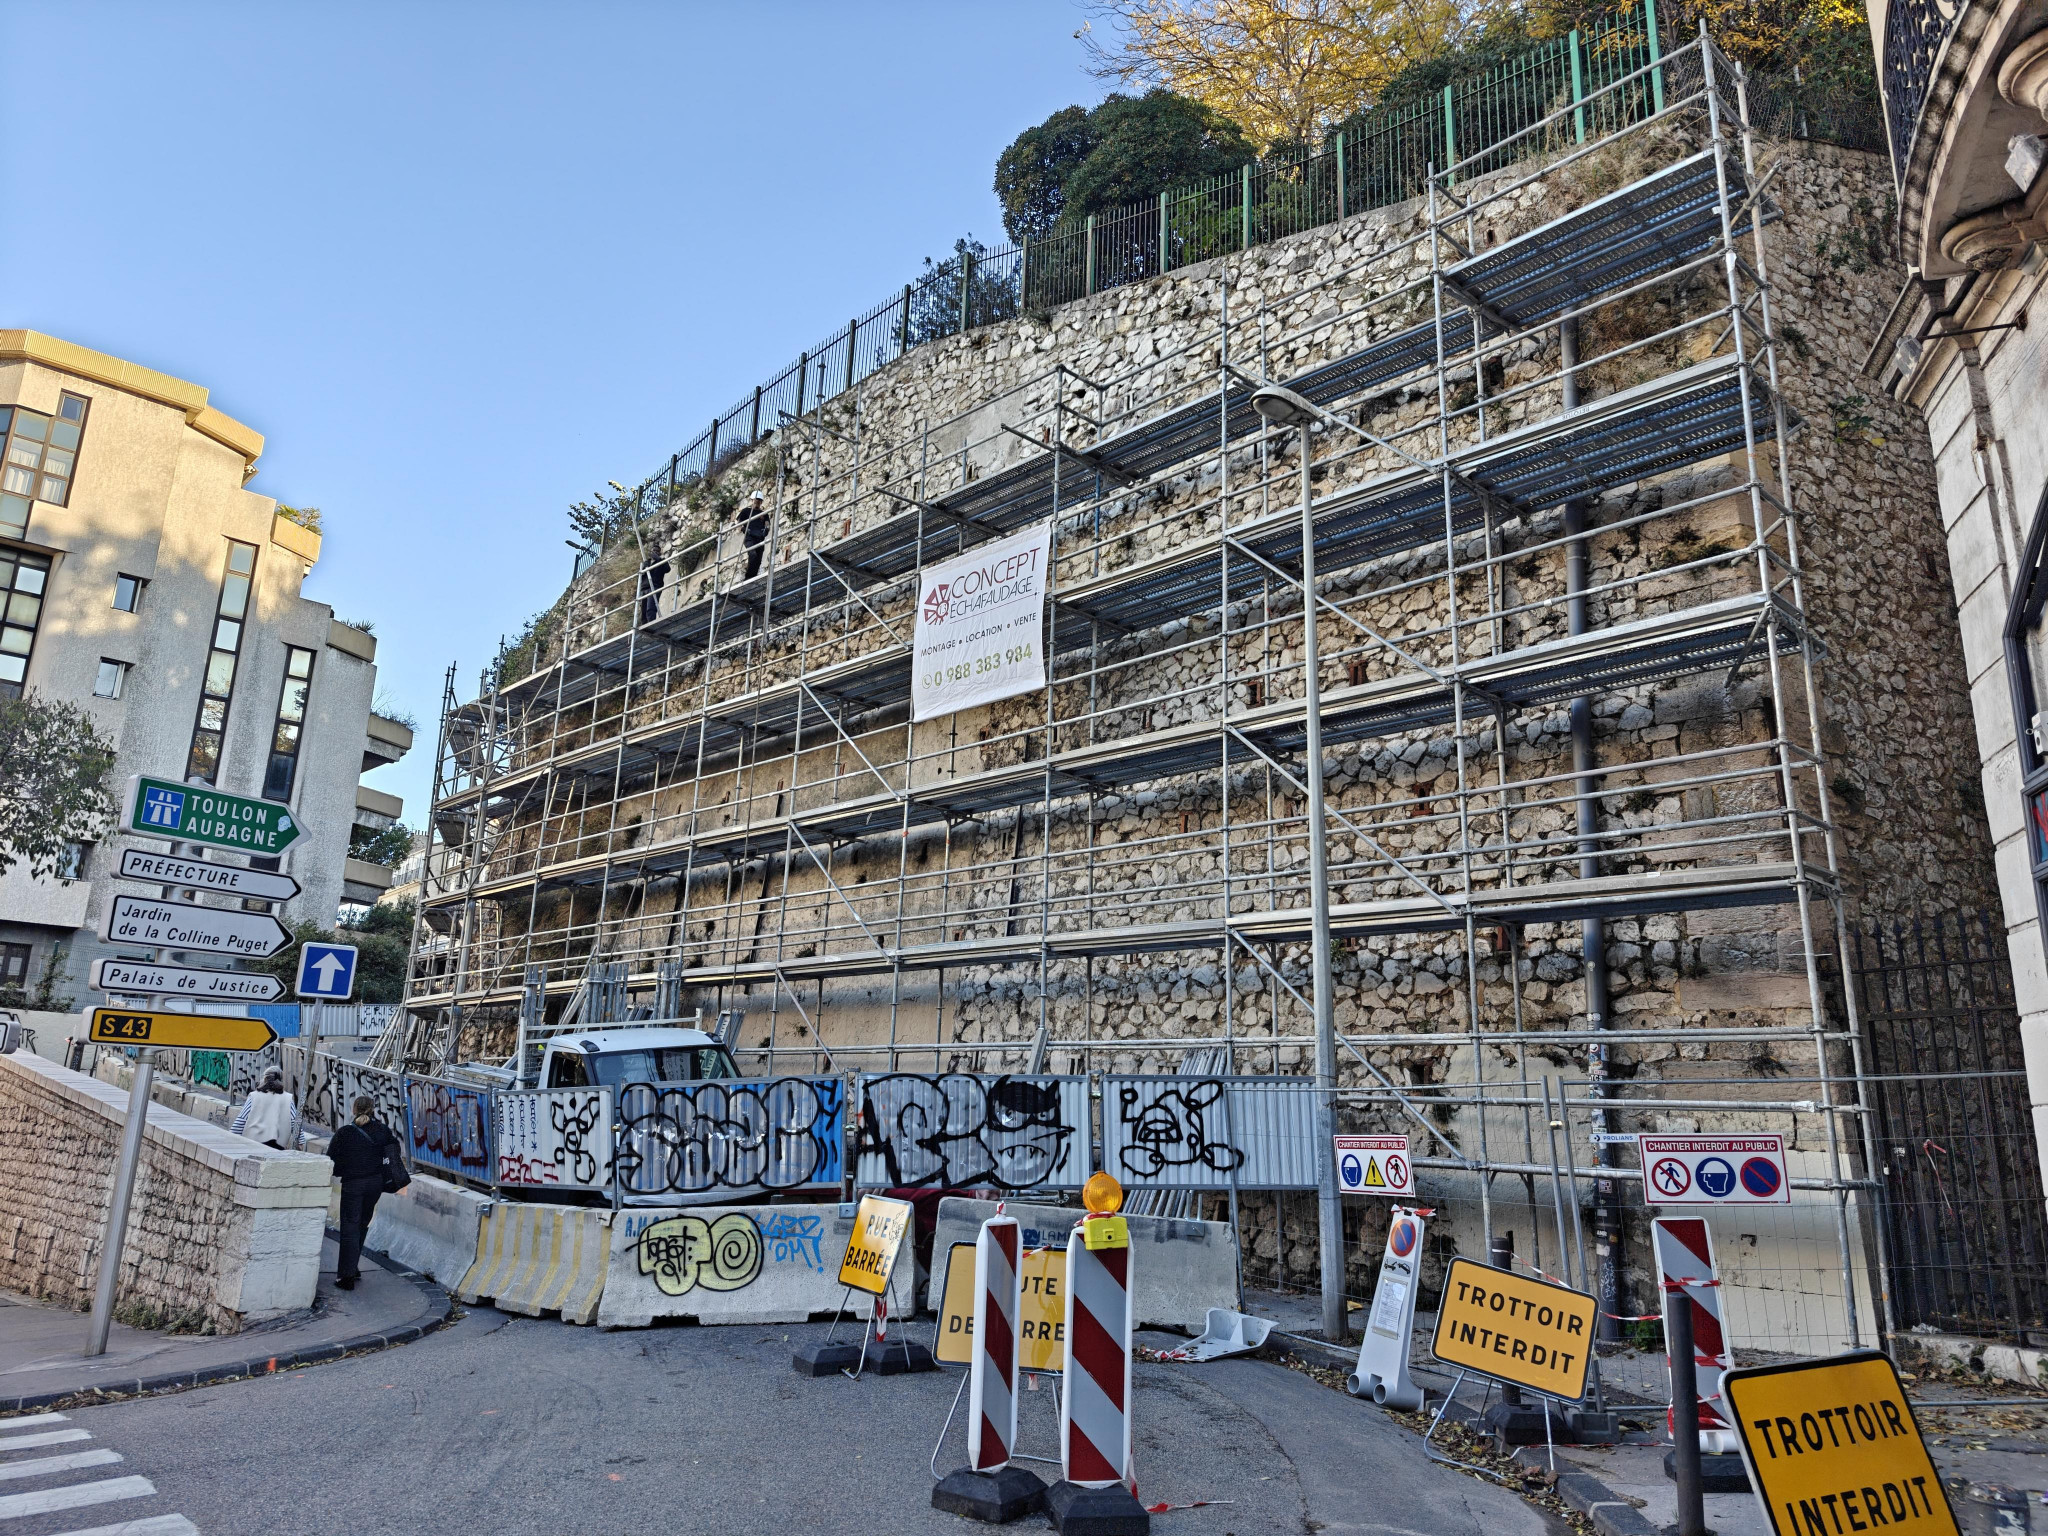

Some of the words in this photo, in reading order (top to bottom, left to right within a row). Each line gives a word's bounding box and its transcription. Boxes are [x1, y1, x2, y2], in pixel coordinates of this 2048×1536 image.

[952, 547, 1041, 599] CONCEPT
[950, 576, 1033, 619] ÉCHAFAUDAGE
[920, 640, 956, 657] MONTAGE
[966, 624, 1003, 643] LOCATION
[1014, 613, 1037, 627] VENTE
[934, 671, 943, 687] 0
[947, 662, 971, 683] 988
[975, 653, 1001, 675] 383
[1005, 643, 1033, 665] 984
[191, 795, 267, 825] TOULON
[186, 817, 277, 848] AUBAGNE
[129, 854, 240, 887] PRÉFECTURE
[122, 904, 172, 922] Jardin
[119, 922, 137, 936] de
[145, 924, 159, 939] la
[167, 927, 220, 946] Colline
[227, 934, 269, 954] Puget
[109, 968, 164, 986] Palais
[178, 975, 197, 989] de
[209, 978, 269, 994] Justice
[102, 1018, 115, 1035] S
[121, 1019, 148, 1037] 43
[1648, 1142, 1690, 1151] CHANTIER
[1692, 1142, 1729, 1151] INTERDIT
[1732, 1142, 1743, 1150] AU
[1746, 1142, 1776, 1150] PUBLIC
[866, 1215, 891, 1239] RUE
[845, 1246, 891, 1277] BARRÉE
[1457, 1282, 1584, 1337] TROTTOIR
[1450, 1320, 1576, 1374] INTERDIT
[1754, 1400, 1908, 1459] TROTTOIR
[1786, 1476, 1933, 1536] INTERDIT
